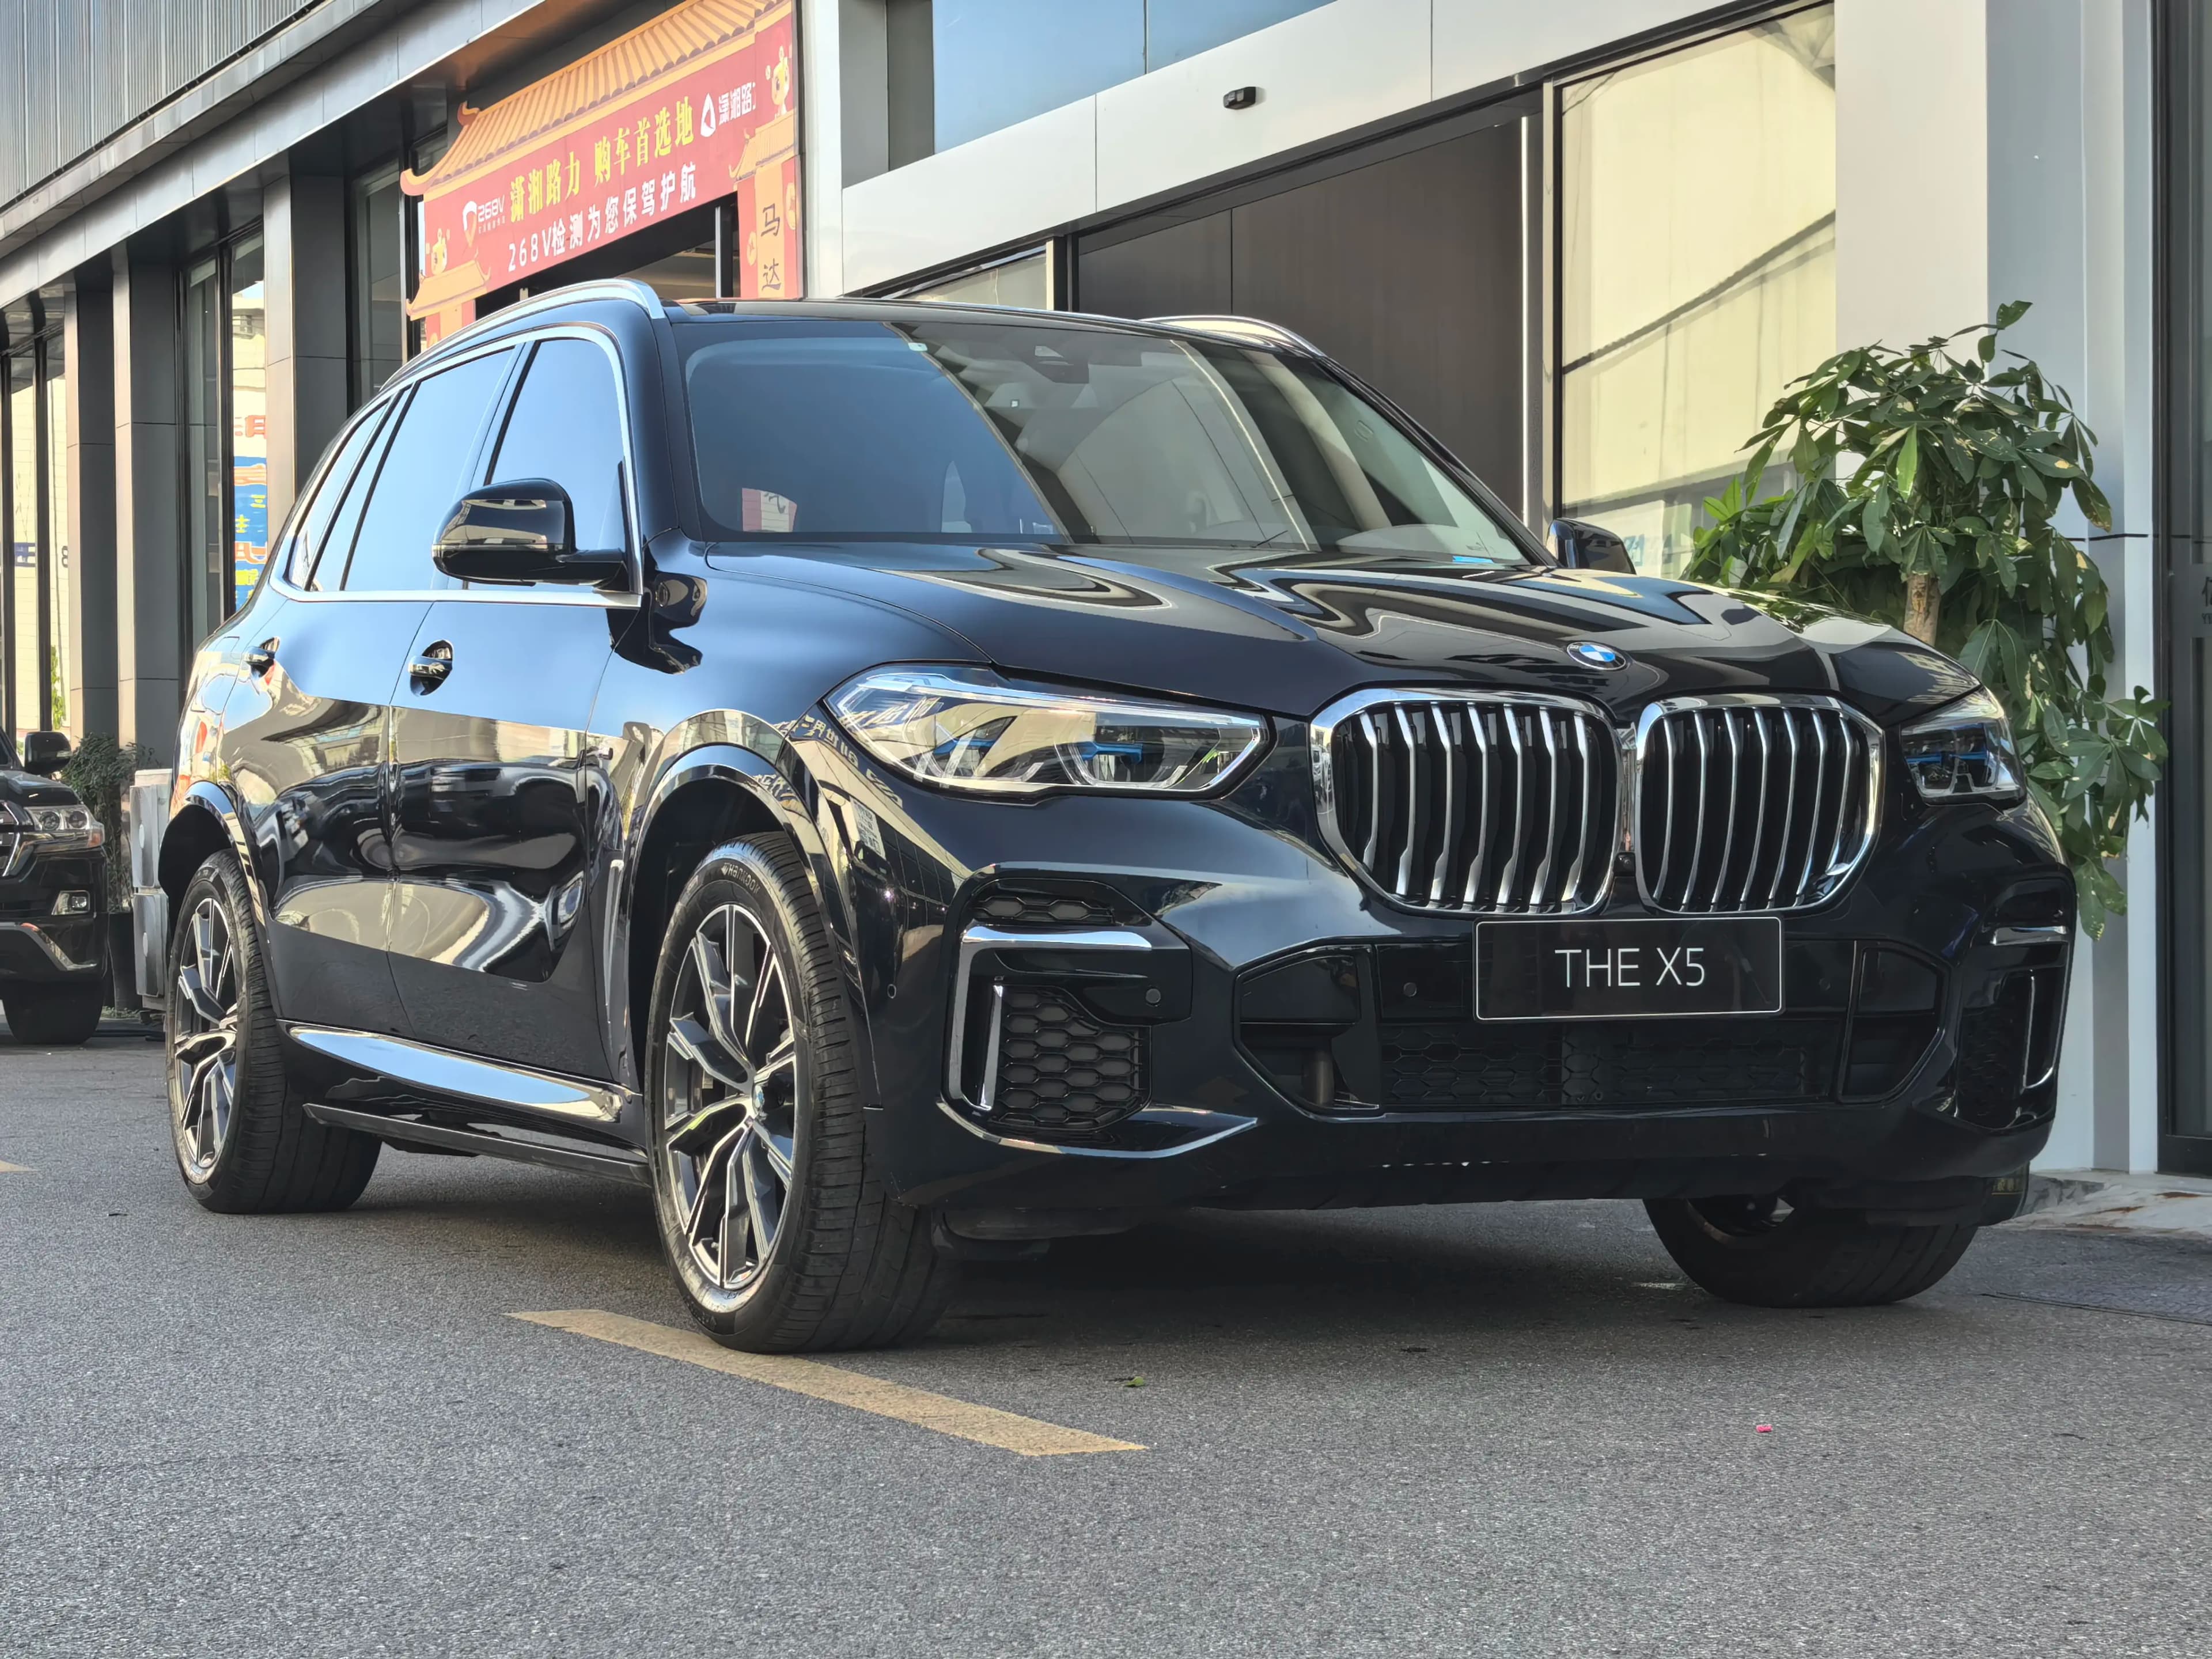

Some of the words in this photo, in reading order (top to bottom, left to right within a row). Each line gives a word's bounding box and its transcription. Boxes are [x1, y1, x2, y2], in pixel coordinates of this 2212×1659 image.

[718, 81, 756, 126] 潇湘路
[594, 96, 694, 188] 购车首选地
[478, 195, 505, 222] 268V
[1555, 948, 1641, 987] THE
[1656, 946, 1705, 986] X5
